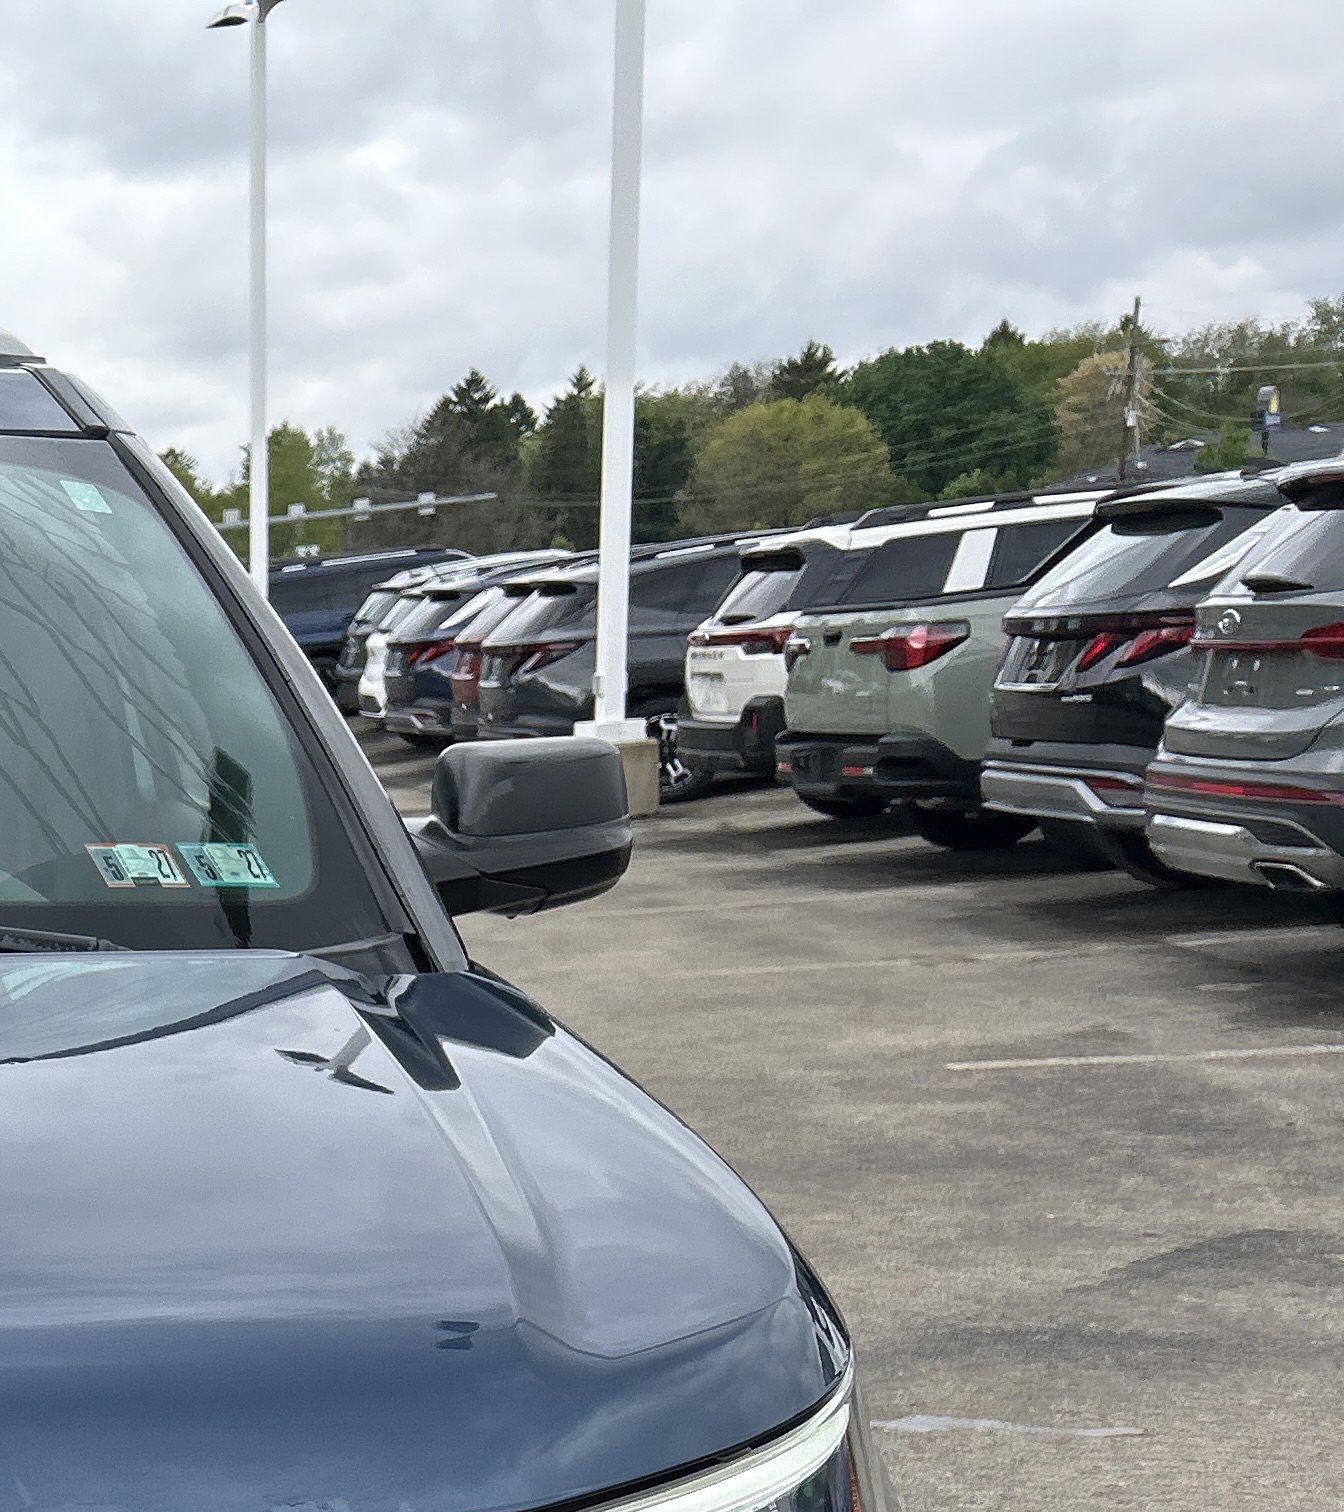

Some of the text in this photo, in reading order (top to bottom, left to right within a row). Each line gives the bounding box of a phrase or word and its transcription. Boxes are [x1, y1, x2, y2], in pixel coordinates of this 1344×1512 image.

[103, 850, 177, 881] 5 27
[195, 849, 267, 881] 5 27
